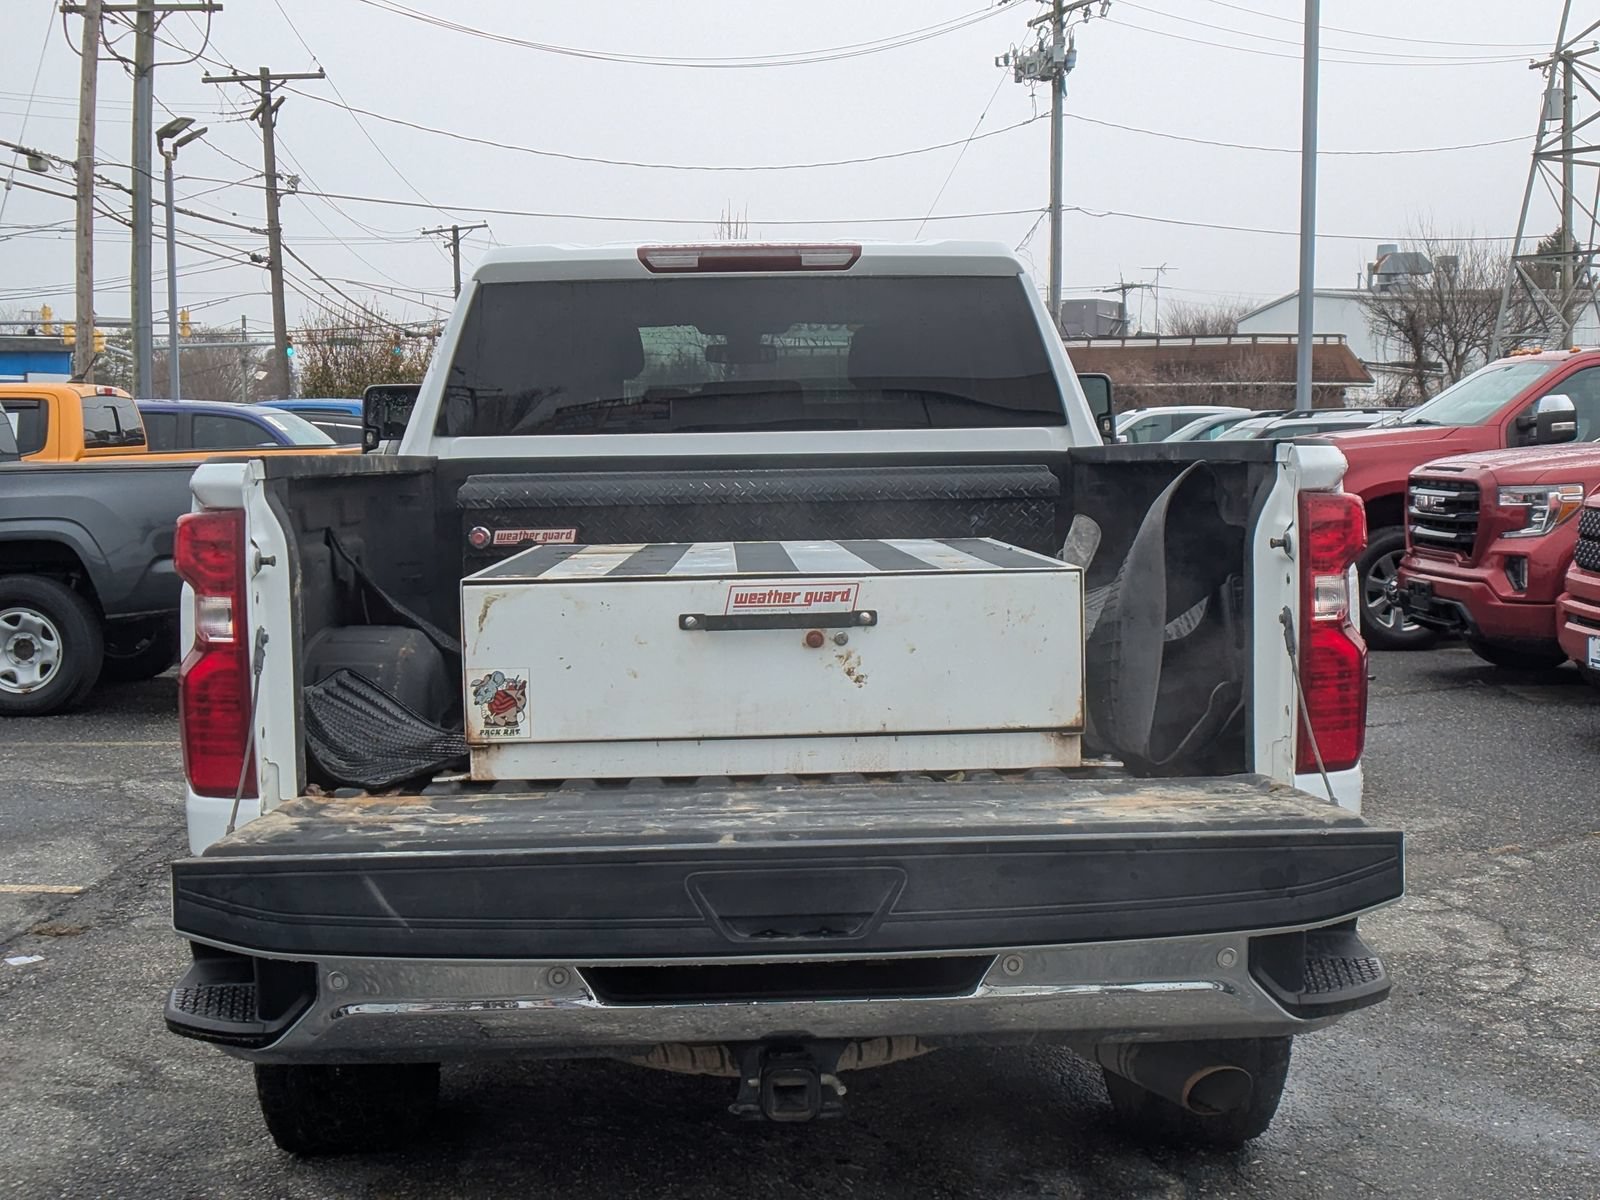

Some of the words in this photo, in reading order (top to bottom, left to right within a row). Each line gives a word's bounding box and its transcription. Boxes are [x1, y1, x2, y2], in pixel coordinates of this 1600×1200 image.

[496, 530, 541, 541] weather
[542, 530, 573, 542] guard
[734, 590, 801, 604] weather
[804, 588, 851, 606] guard
[480, 729, 502, 737] PACK
[503, 729, 521, 737] RAT
